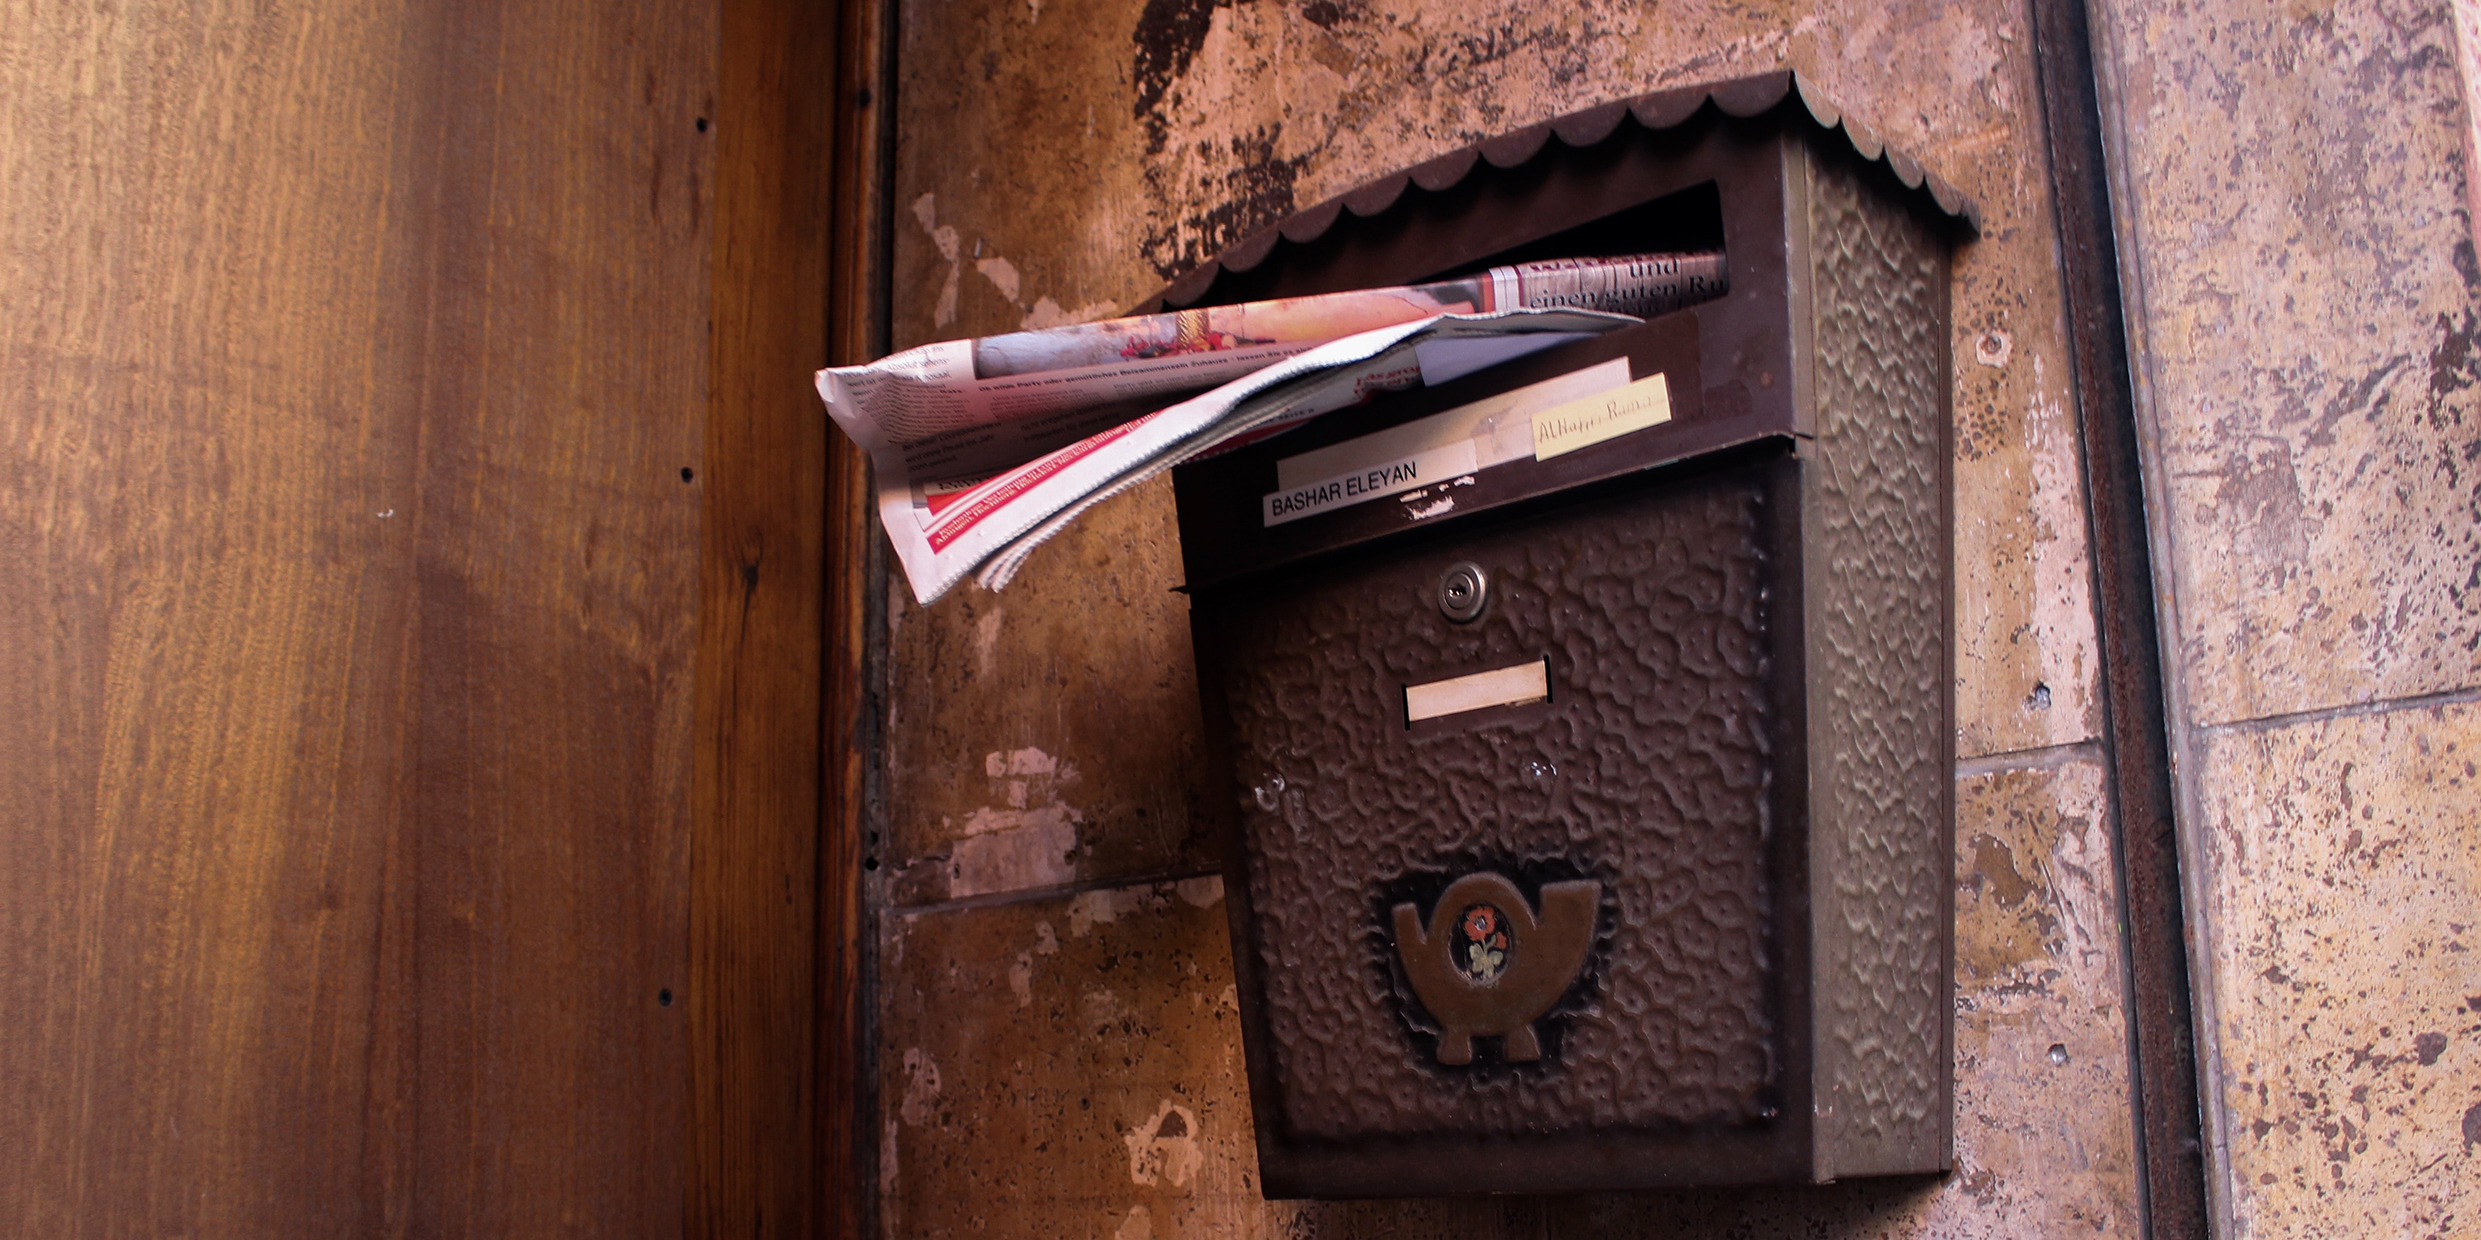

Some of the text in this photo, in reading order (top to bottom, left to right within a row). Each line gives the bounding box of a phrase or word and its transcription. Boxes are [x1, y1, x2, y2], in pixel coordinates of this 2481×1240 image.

[1630, 256, 1679, 279] und
[1530, 288, 1596, 309] einen
[1603, 283, 1679, 305] guten
[1272, 461, 1417, 517] BASHAR ELEYAN
